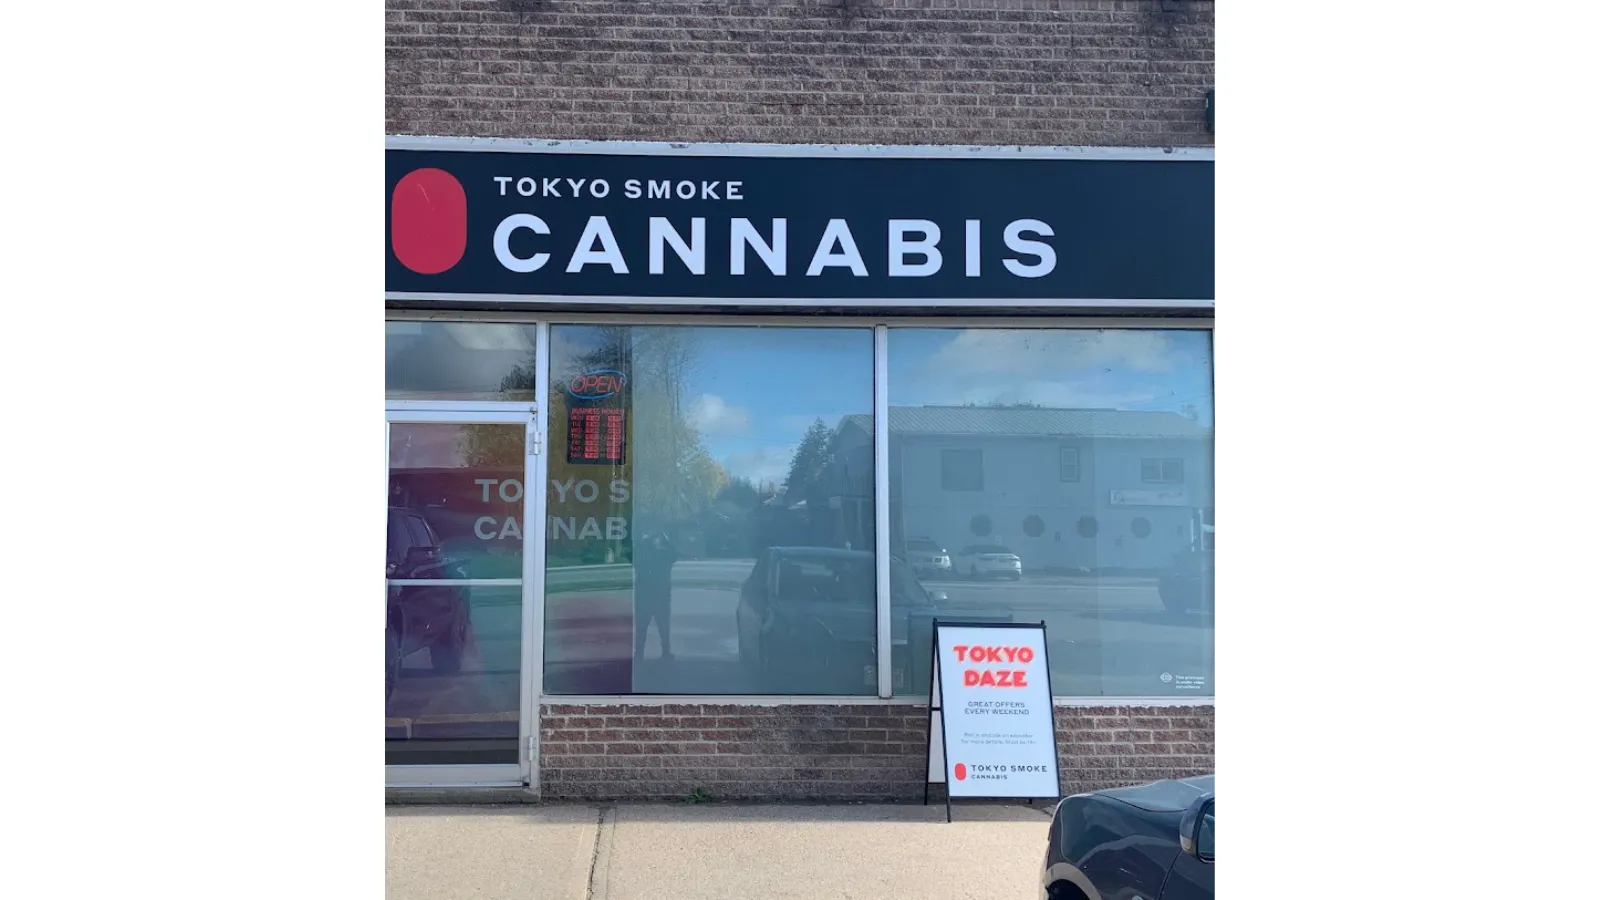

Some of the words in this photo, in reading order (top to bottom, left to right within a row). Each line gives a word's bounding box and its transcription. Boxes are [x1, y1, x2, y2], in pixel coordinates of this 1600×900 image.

[493, 176, 610, 198] TOKYO
[624, 179, 745, 200] SMOKE
[493, 213, 1057, 279] CANNABIS
[571, 375, 624, 393] OPEN
[474, 478, 600, 504] TOYO
[953, 645, 1034, 664] TOKYO
[963, 669, 1028, 688] DAZE
[992, 708, 1030, 716] WEEKEND
[995, 701, 1026, 709] OFFERS
[971, 764, 1007, 772] TOKYO
